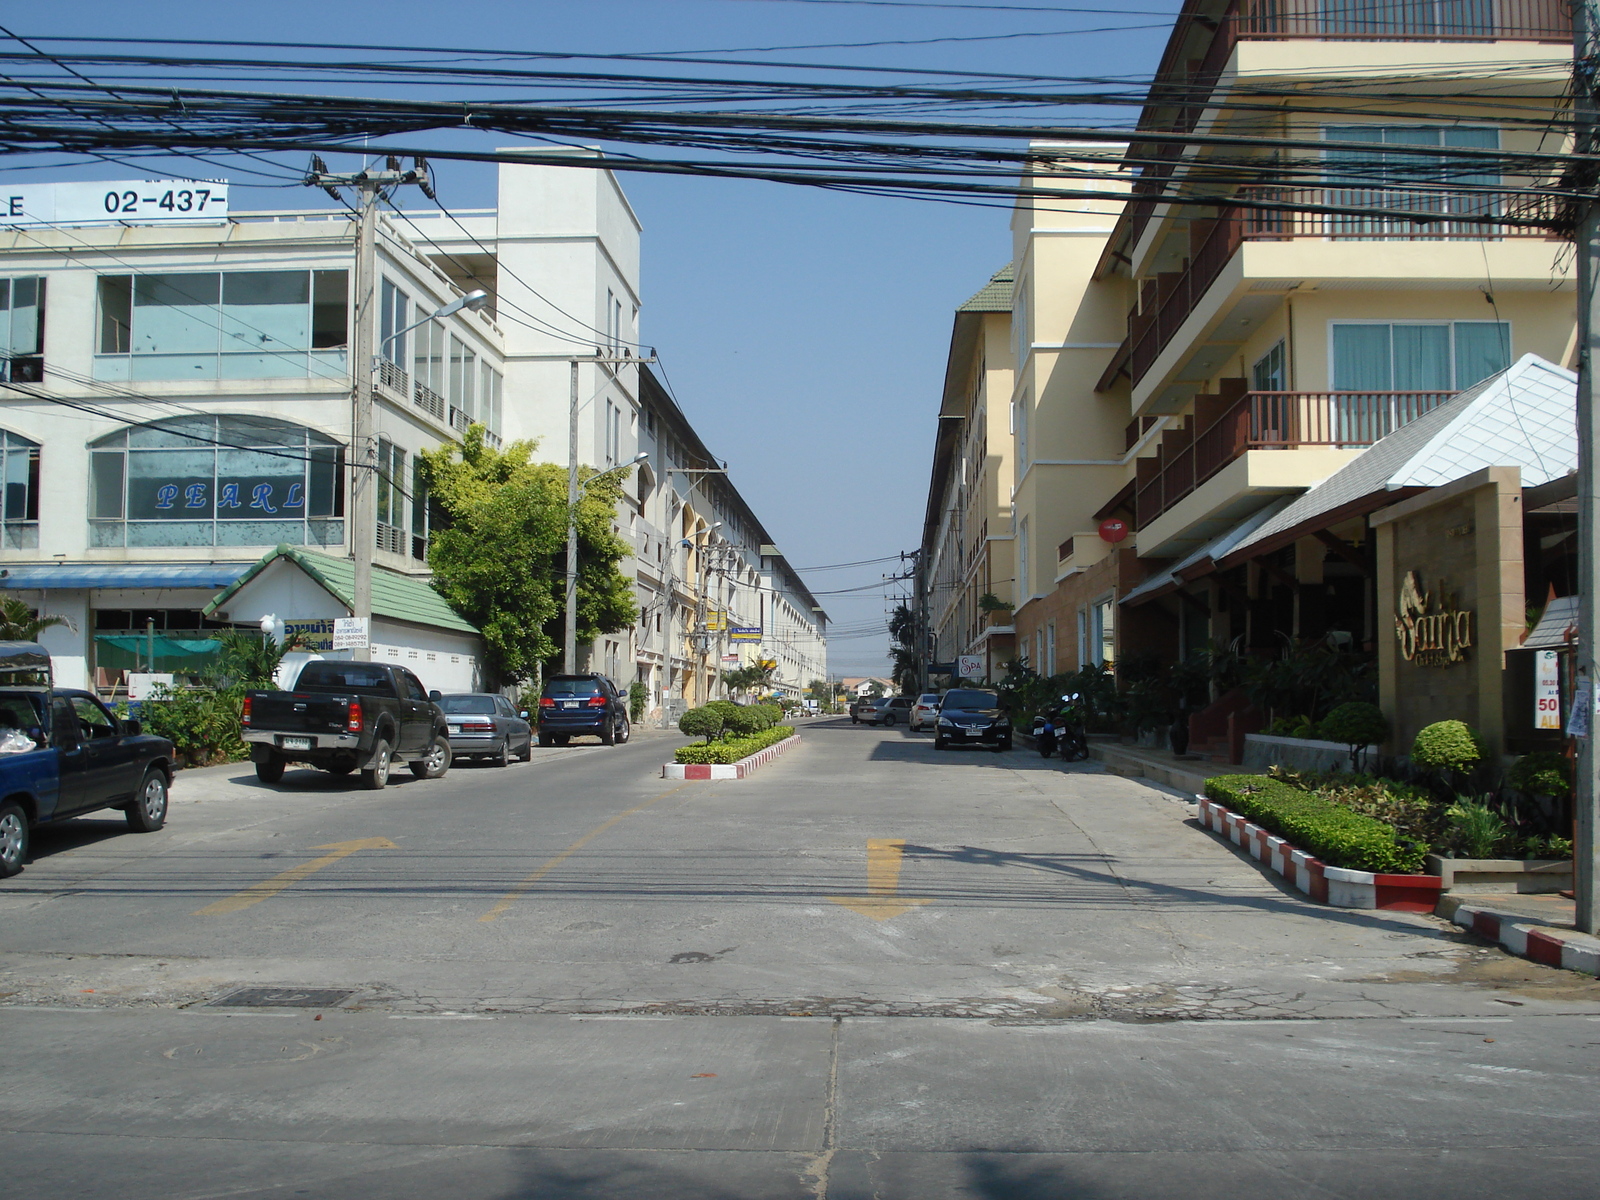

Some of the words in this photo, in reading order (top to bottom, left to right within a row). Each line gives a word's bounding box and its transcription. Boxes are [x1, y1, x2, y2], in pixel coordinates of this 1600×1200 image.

[104, 189, 226, 213] 02-437-
[155, 482, 305, 513] PEARL
[1538, 698, 1558, 711] 50
